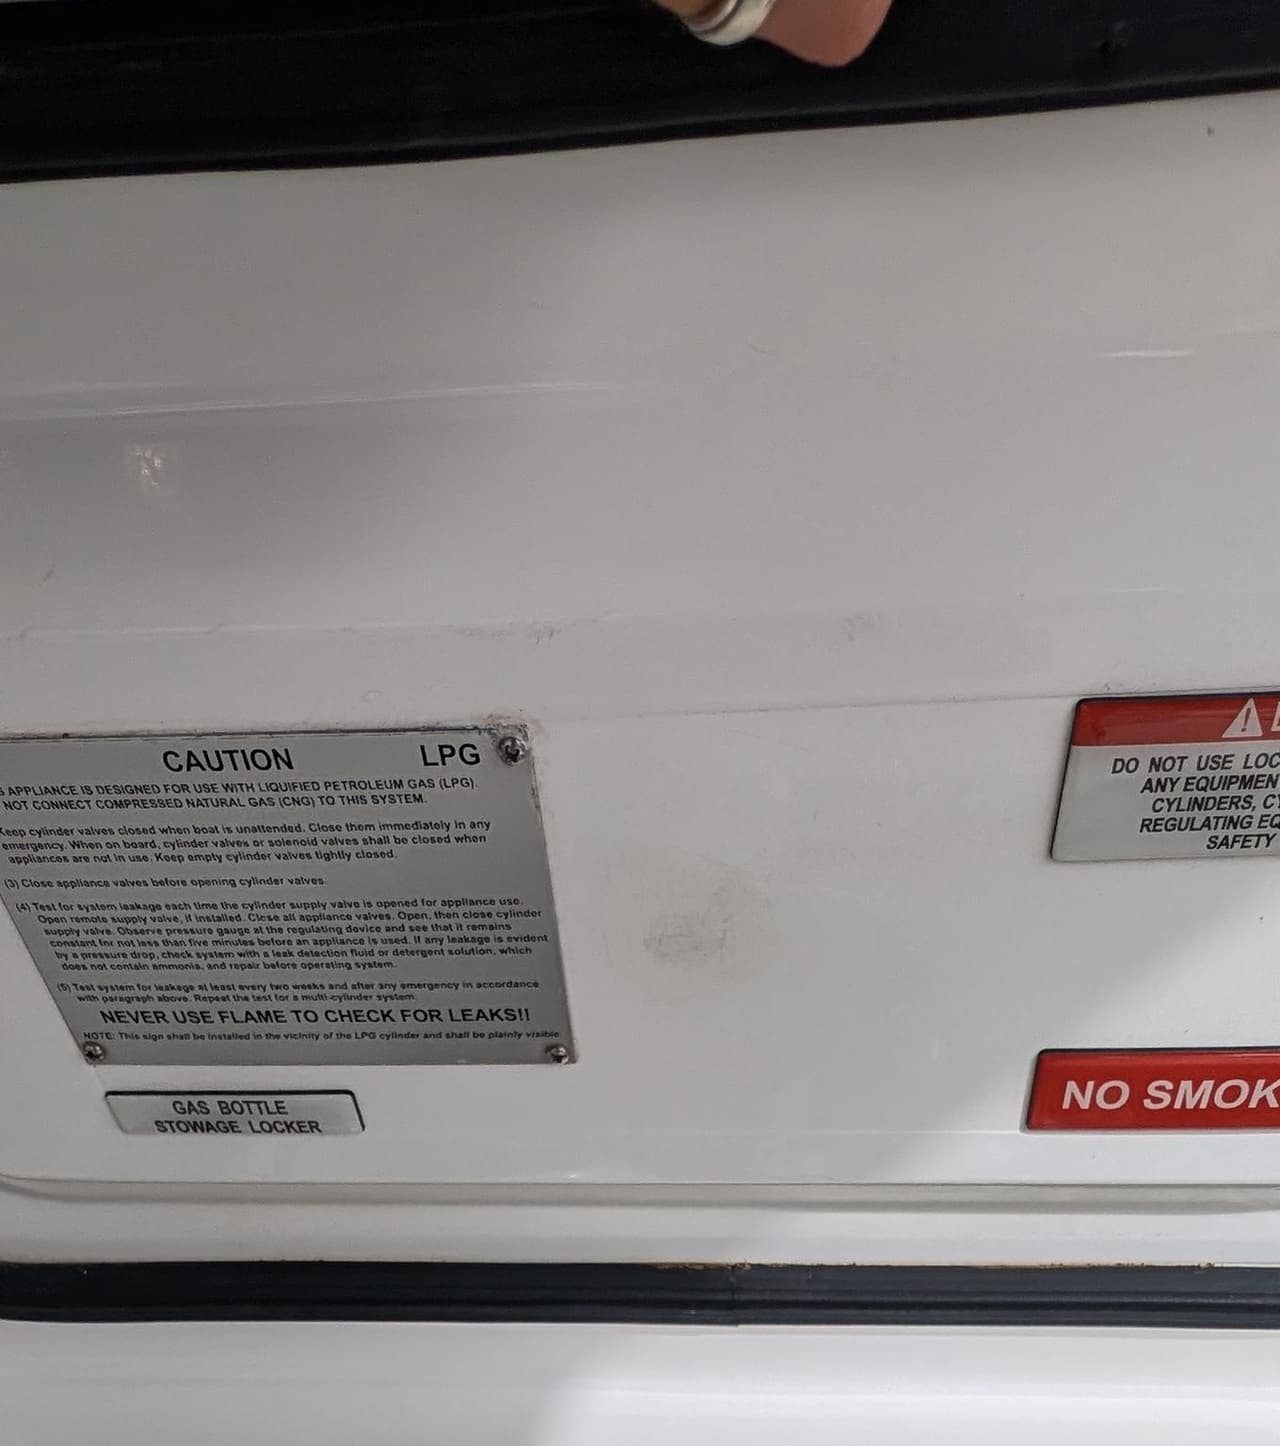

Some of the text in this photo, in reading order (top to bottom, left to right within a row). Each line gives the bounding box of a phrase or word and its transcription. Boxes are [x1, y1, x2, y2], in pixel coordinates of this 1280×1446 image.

[162, 743, 481, 773] CAUTION LPG
[1111, 757, 1140, 774] DO
[1148, 756, 1188, 773] NOT
[1196, 754, 1235, 771] USE
[8, 785, 80, 799] APPLIANCE
[79, 785, 94, 796] IS
[94, 784, 161, 795] DESIGNED
[162, 783, 192, 794] FOR
[192, 783, 220, 794] USE
[220, 782, 255, 794] WITH
[257, 781, 321, 793] LIQUIFIED
[323, 778, 404, 791] PETROLEUM
[407, 778, 436, 790] GAS
[439, 777, 478, 789] (LPG).
[1140, 777, 1181, 794] ANY
[2, 800, 29, 811] NOT
[32, 799, 92, 811] CONNECT
[95, 798, 183, 810] COMPRESSED
[185, 797, 247, 808] NATURAL
[247, 796, 276, 807] GAS
[278, 796, 316, 809] (CNG)
[317, 795, 336, 806] TO
[337, 794, 368, 806] THIS
[368, 791, 427, 805] SYSTEM.
[1152, 794, 1256, 813] CYLINDERS,
[28, 826, 74, 839] cylinder
[77, 826, 115, 836] valves
[117, 825, 157, 836] closed
[158, 825, 191, 835] when
[191, 824, 220, 835] boat
[221, 824, 233, 834] is
[308, 822, 343, 833] Close
[345, 822, 376, 832] them
[378, 820, 451, 832] immediately
[454, 820, 466, 830] in
[469, 821, 491, 831] any
[1139, 815, 1254, 833] REGULATING
[67, 840, 103, 850] When
[105, 841, 122, 849] on
[162, 838, 209, 851] cylinder
[211, 838, 250, 848] valves
[252, 839, 265, 847] or
[267, 836, 318, 847] solenoid
[320, 836, 359, 846] valves
[361, 834, 391, 846] shall
[392, 834, 408, 845] be
[411, 833, 451, 845] closed
[454, 833, 487, 844] when
[1206, 833, 1277, 850] SAFETY
[8, 854, 70, 866] appliances
[71, 855, 90, 863] are
[93, 854, 112, 863] not
[113, 853, 126, 863] in
[154, 852, 185, 865] Keep
[187, 852, 223, 864] empty
[225, 851, 272, 864] cylinder
[273, 850, 313, 861] valves
[314, 849, 352, 862] tightly
[3, 879, 20, 890] (3)
[21, 878, 54, 888] Close
[56, 878, 110, 890] appliance
[112, 878, 149, 887] valves
[150, 877, 188, 887] before
[190, 878, 237, 889] opening
[239, 876, 284, 888] cylinder
[15, 902, 31, 913] (4)
[31, 902, 57, 912] Test
[58, 902, 74, 911] for
[77, 903, 118, 913] system
[118, 902, 162, 912] leakage
[164, 901, 192, 911] each
[192, 901, 219, 910] time
[220, 901, 239, 910] the
[241, 900, 287, 911] cylinder
[289, 900, 327, 910] supply
[329, 899, 361, 909] valve
[362, 899, 373, 908] is
[376, 898, 419, 909] opened
[420, 898, 437, 907] for
[440, 897, 496, 908] appliance
[99, 1008, 530, 1025] NEVER USE FLAME TO CHECK FOR LEAKS!!
[1062, 1080, 1130, 1110] NO
[172, 1100, 288, 1115] GAS BOTTLE
[154, 1120, 322, 1134] STOWAGE LOCKER
